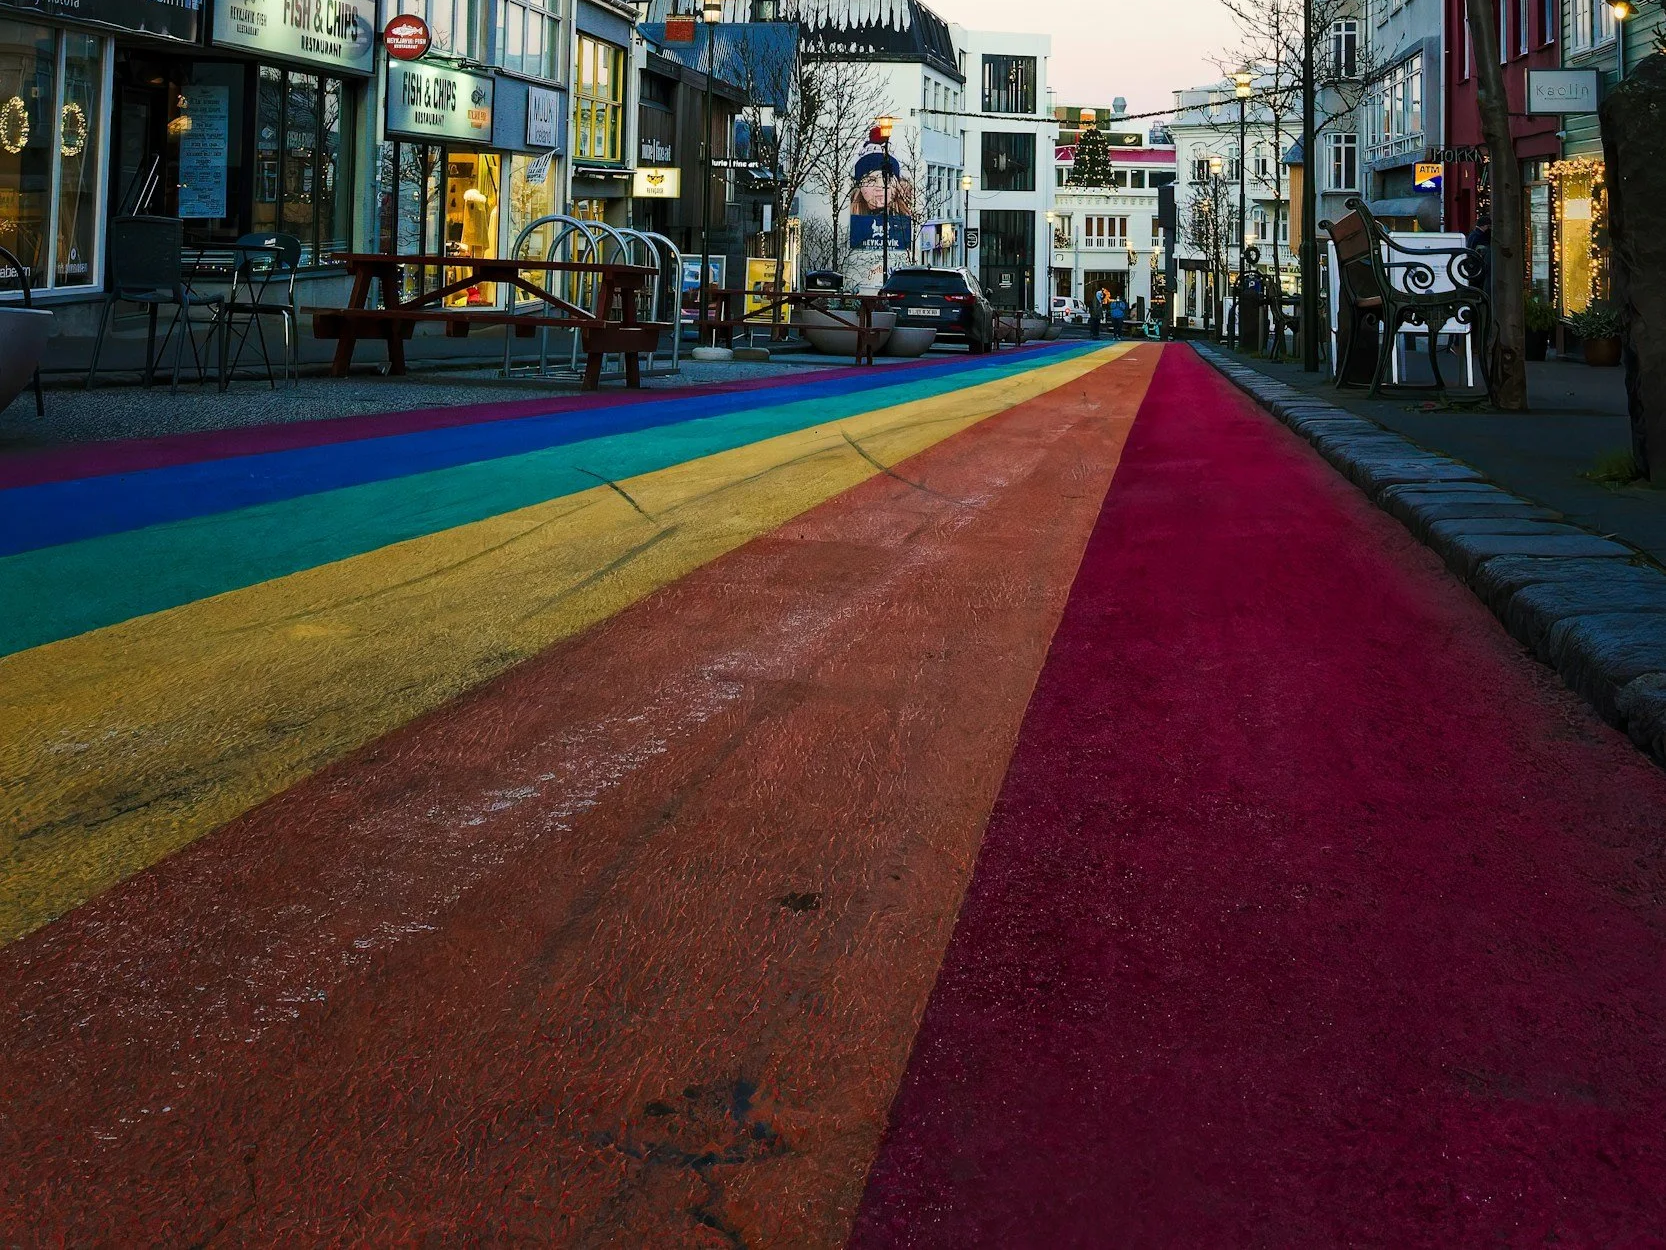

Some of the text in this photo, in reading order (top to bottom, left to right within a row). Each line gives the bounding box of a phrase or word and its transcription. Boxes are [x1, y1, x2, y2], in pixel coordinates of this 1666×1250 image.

[256, 12, 267, 27] FISH
[301, 35, 342, 58] RESTAURANT
[402, 71, 457, 112] FISH & CHIPS
[1536, 83, 1589, 96] Kaolin
[415, 111, 445, 127] RESTAURANT
[1420, 165, 1440, 174] ATM
[862, 238, 900, 247] REYKJVÍK
